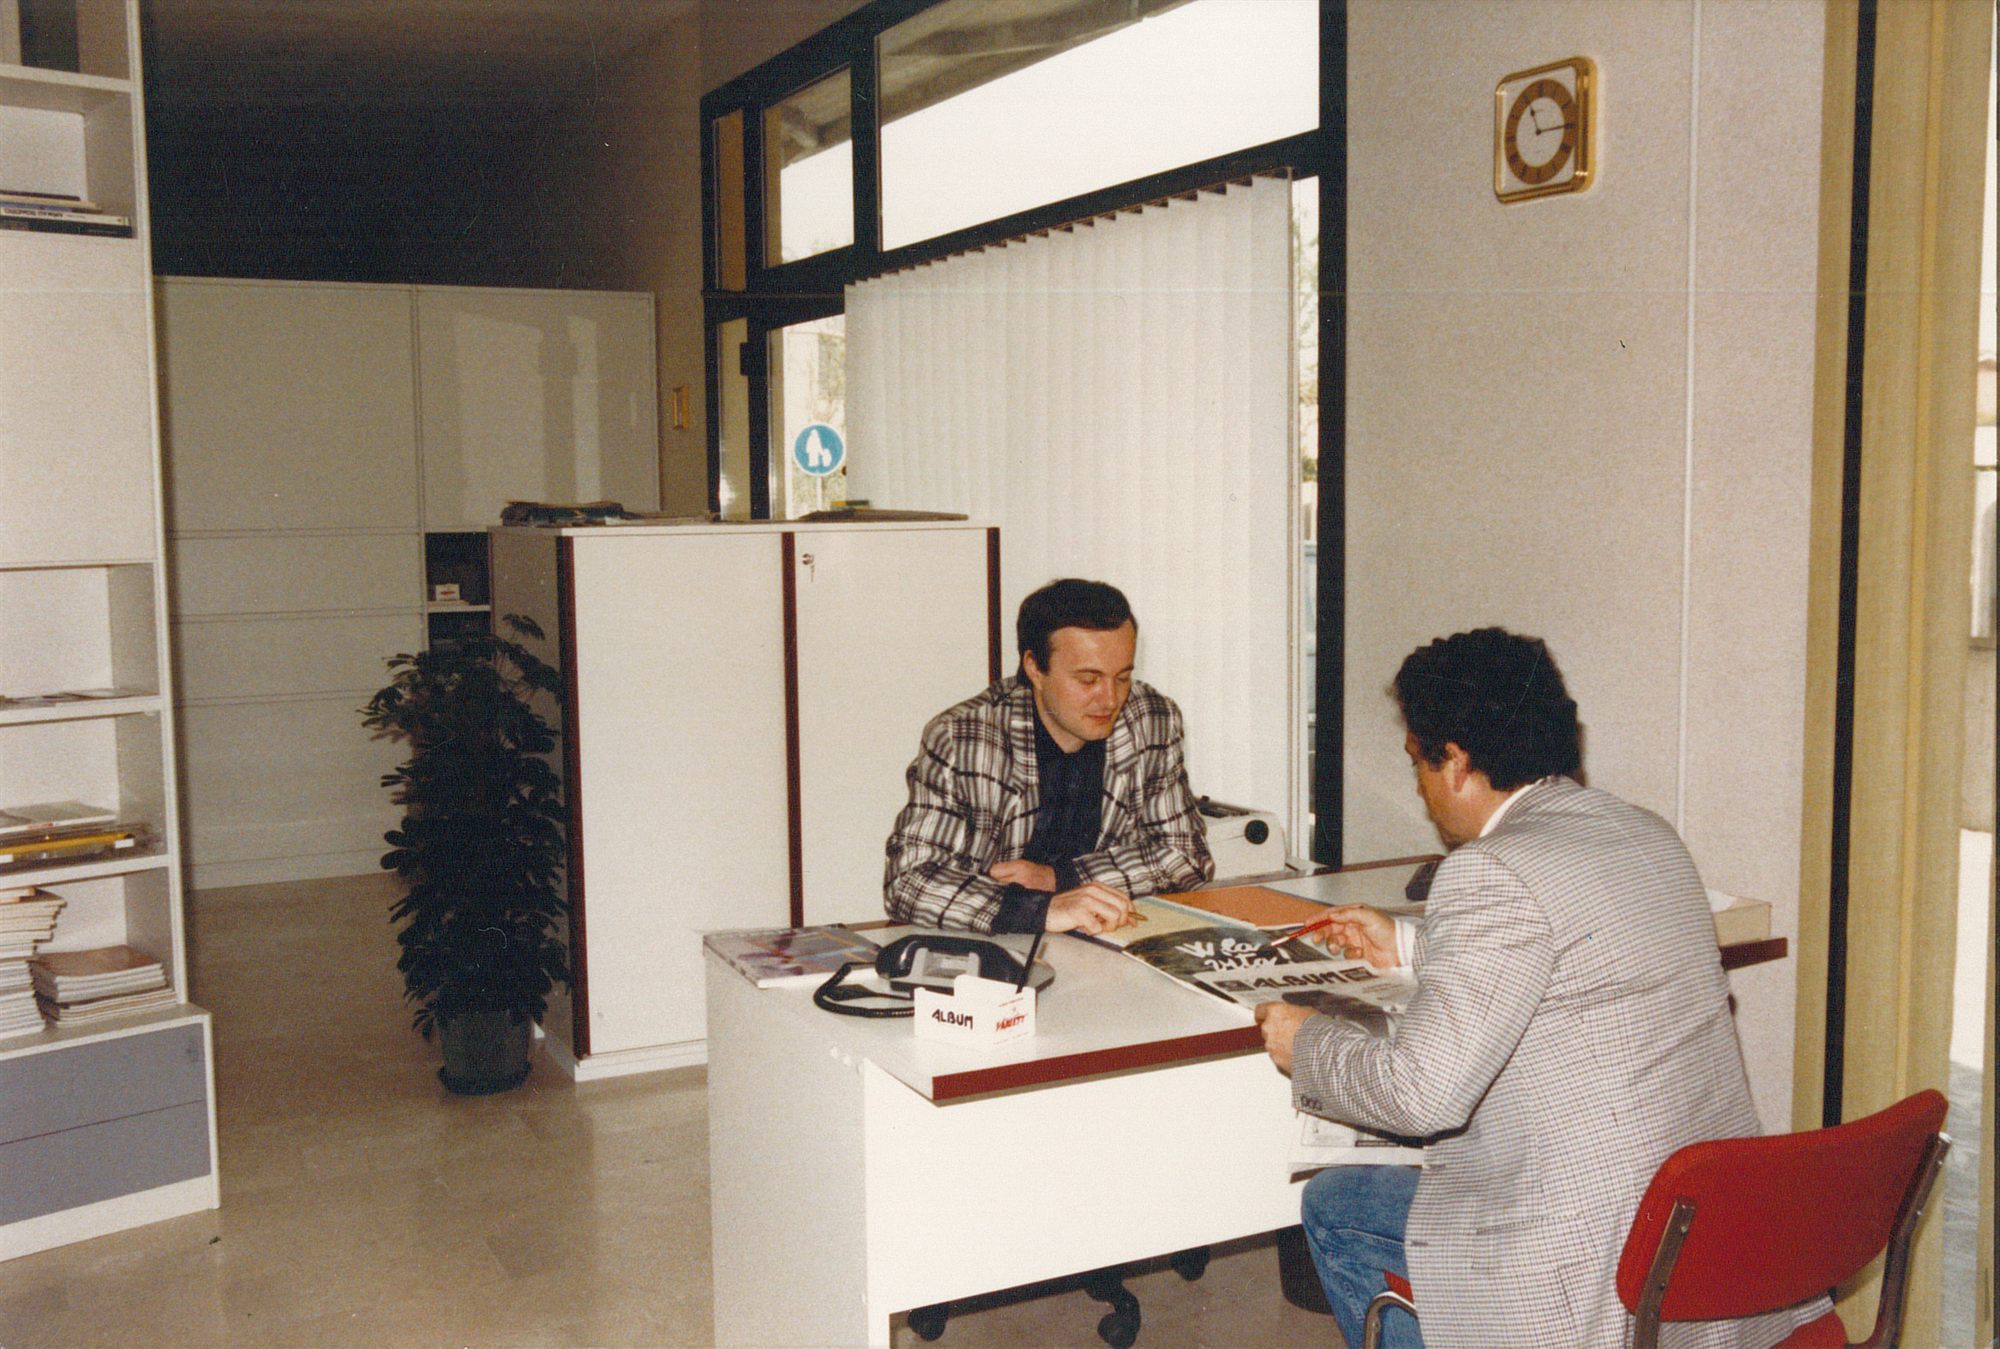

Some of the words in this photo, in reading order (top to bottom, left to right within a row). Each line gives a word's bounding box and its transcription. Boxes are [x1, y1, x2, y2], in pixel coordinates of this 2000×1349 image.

[1219, 938, 1262, 957] la
[1252, 971, 1348, 989] ALBUM
[931, 1008, 974, 1030] ALBUM
